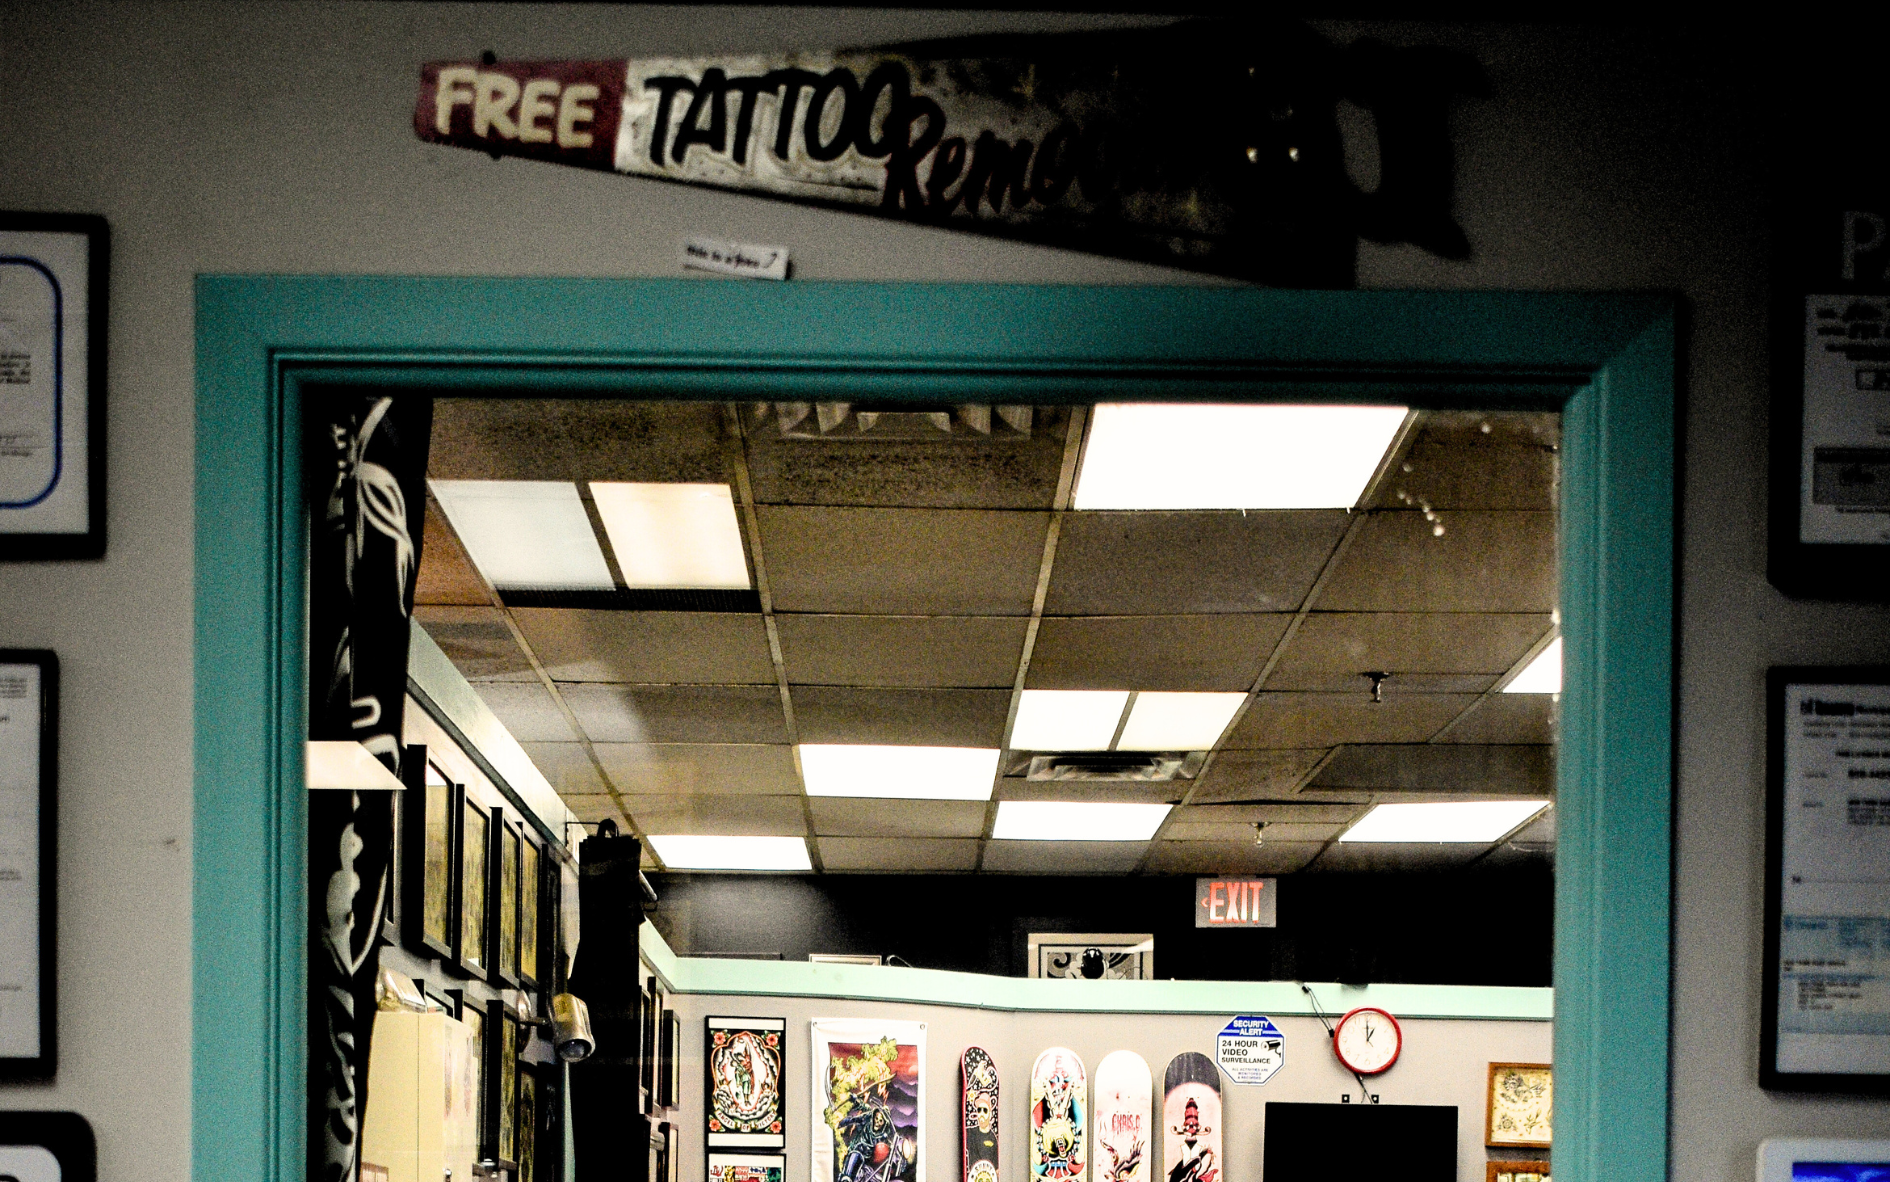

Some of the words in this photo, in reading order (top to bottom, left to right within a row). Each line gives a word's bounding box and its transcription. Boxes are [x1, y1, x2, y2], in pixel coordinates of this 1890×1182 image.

[434, 65, 600, 149] FREE
[644, 62, 912, 167] TATTOO
[1209, 881, 1264, 924] EXIT
[1233, 1020, 1269, 1028] SECURITY
[1239, 1028, 1263, 1036] ALERT
[1234, 1040, 1258, 1048] HOUR
[1222, 1048, 1248, 1056] VIDEO
[1221, 1057, 1271, 1065] SURVEILLANCE
